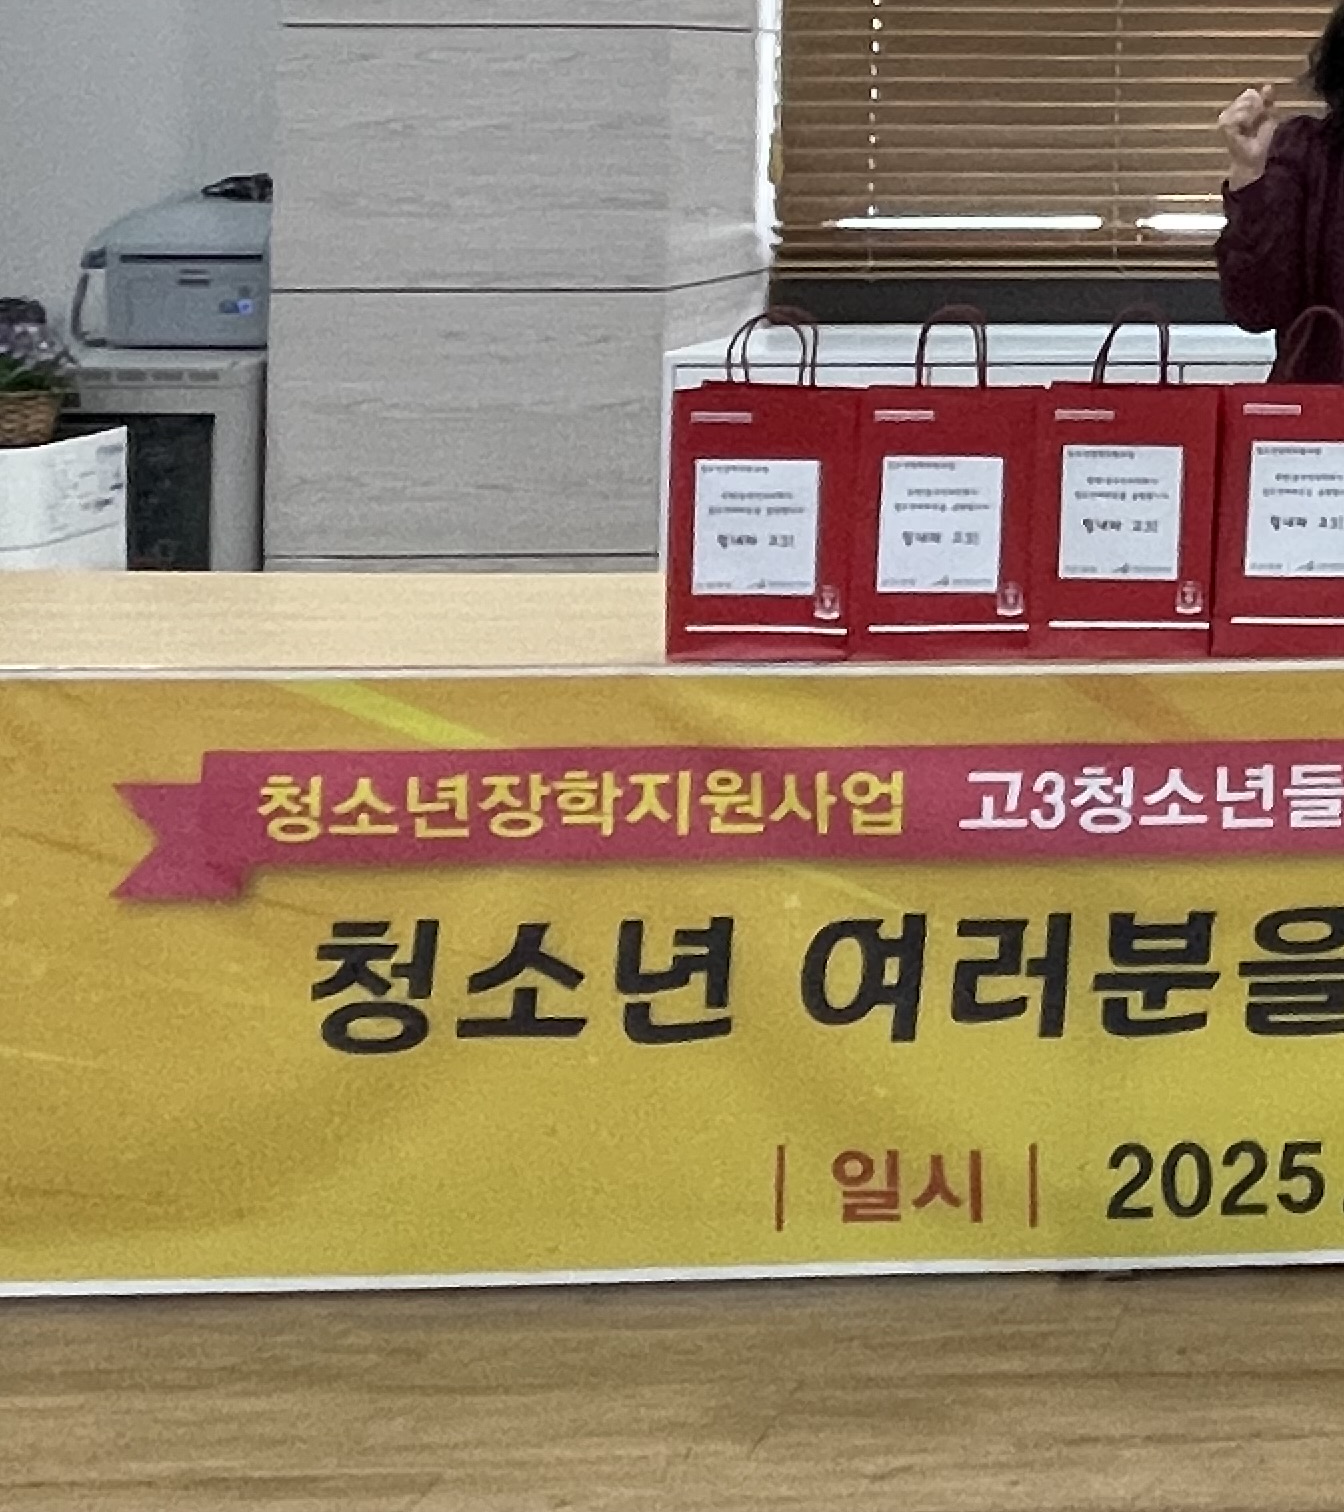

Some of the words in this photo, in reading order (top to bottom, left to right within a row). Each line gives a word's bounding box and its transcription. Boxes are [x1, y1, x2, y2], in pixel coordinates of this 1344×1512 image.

[257, 770, 903, 841] 청소년장학지원사업
[313, 917, 733, 1053] 청소년
[830, 1144, 985, 1224] 일시
